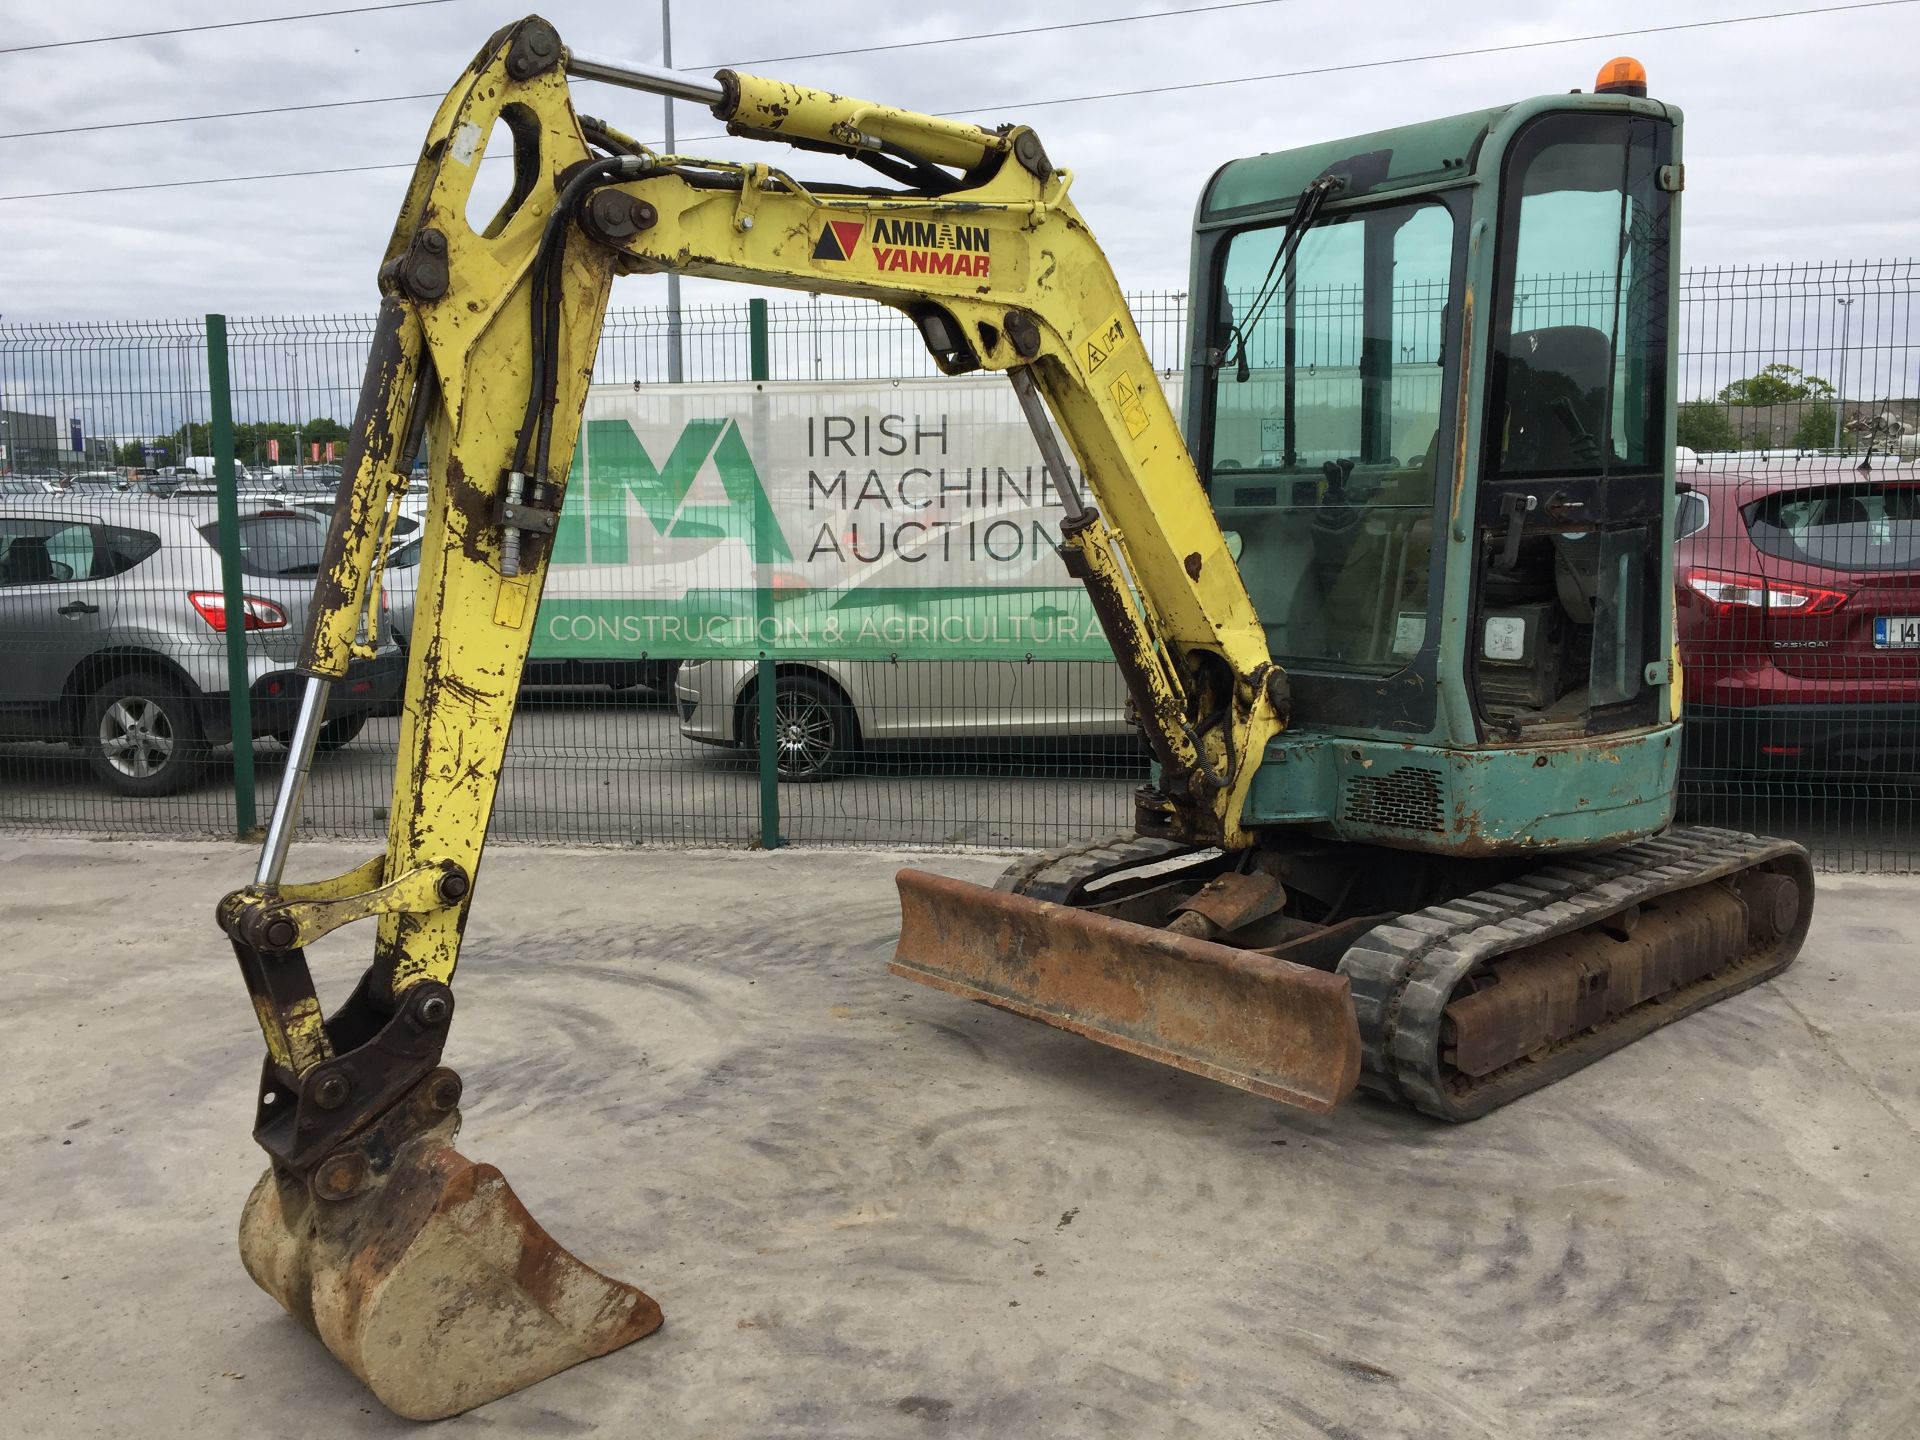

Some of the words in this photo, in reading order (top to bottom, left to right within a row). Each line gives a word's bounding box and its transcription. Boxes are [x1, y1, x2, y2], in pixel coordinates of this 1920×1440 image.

[872, 218, 990, 252] AMMANN
[872, 247, 990, 278] YANMAR
[808, 414, 947, 457] IRISH
[549, 615, 809, 643] CONSTRUCTION
[822, 616, 846, 643] &
[857, 615, 1108, 643] AGRICULTURA
